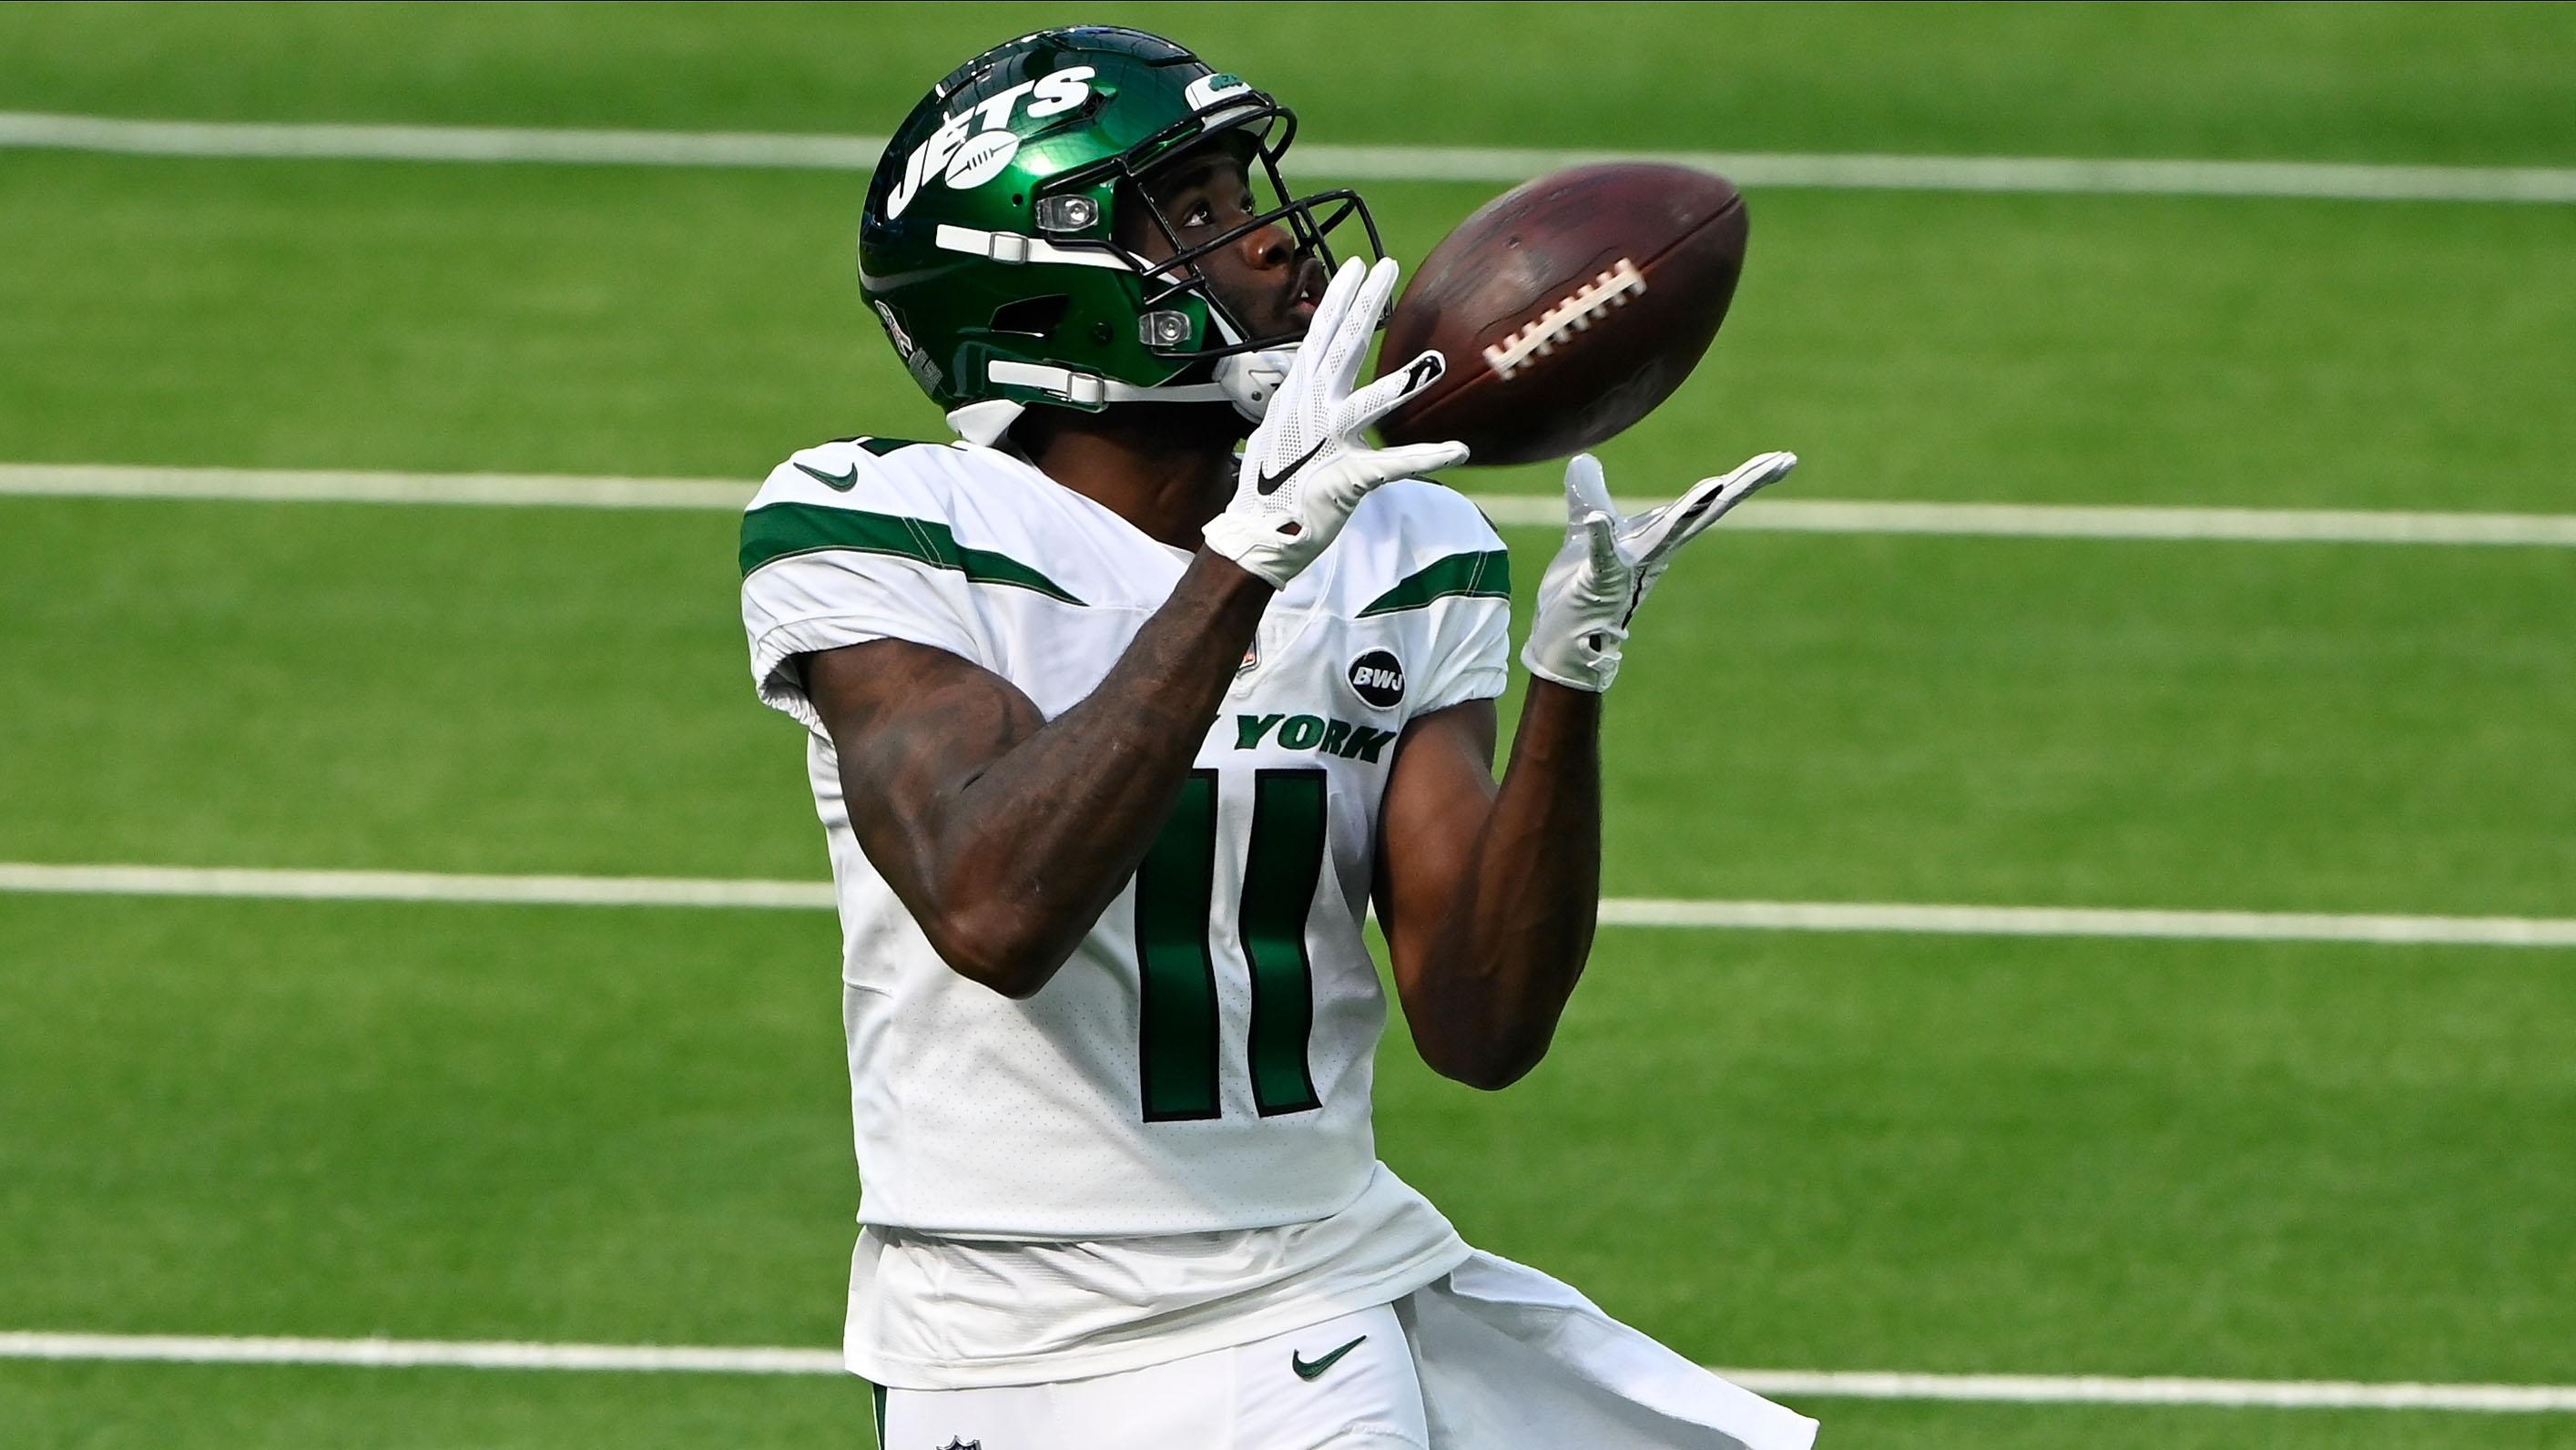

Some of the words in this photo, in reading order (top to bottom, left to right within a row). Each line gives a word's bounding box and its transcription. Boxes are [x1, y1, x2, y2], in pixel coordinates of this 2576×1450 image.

[887, 66, 1095, 220] JETS
[1353, 666, 1402, 691] BWJ
[1234, 714, 1397, 763] YORK
[1135, 768, 1328, 1123] 11
